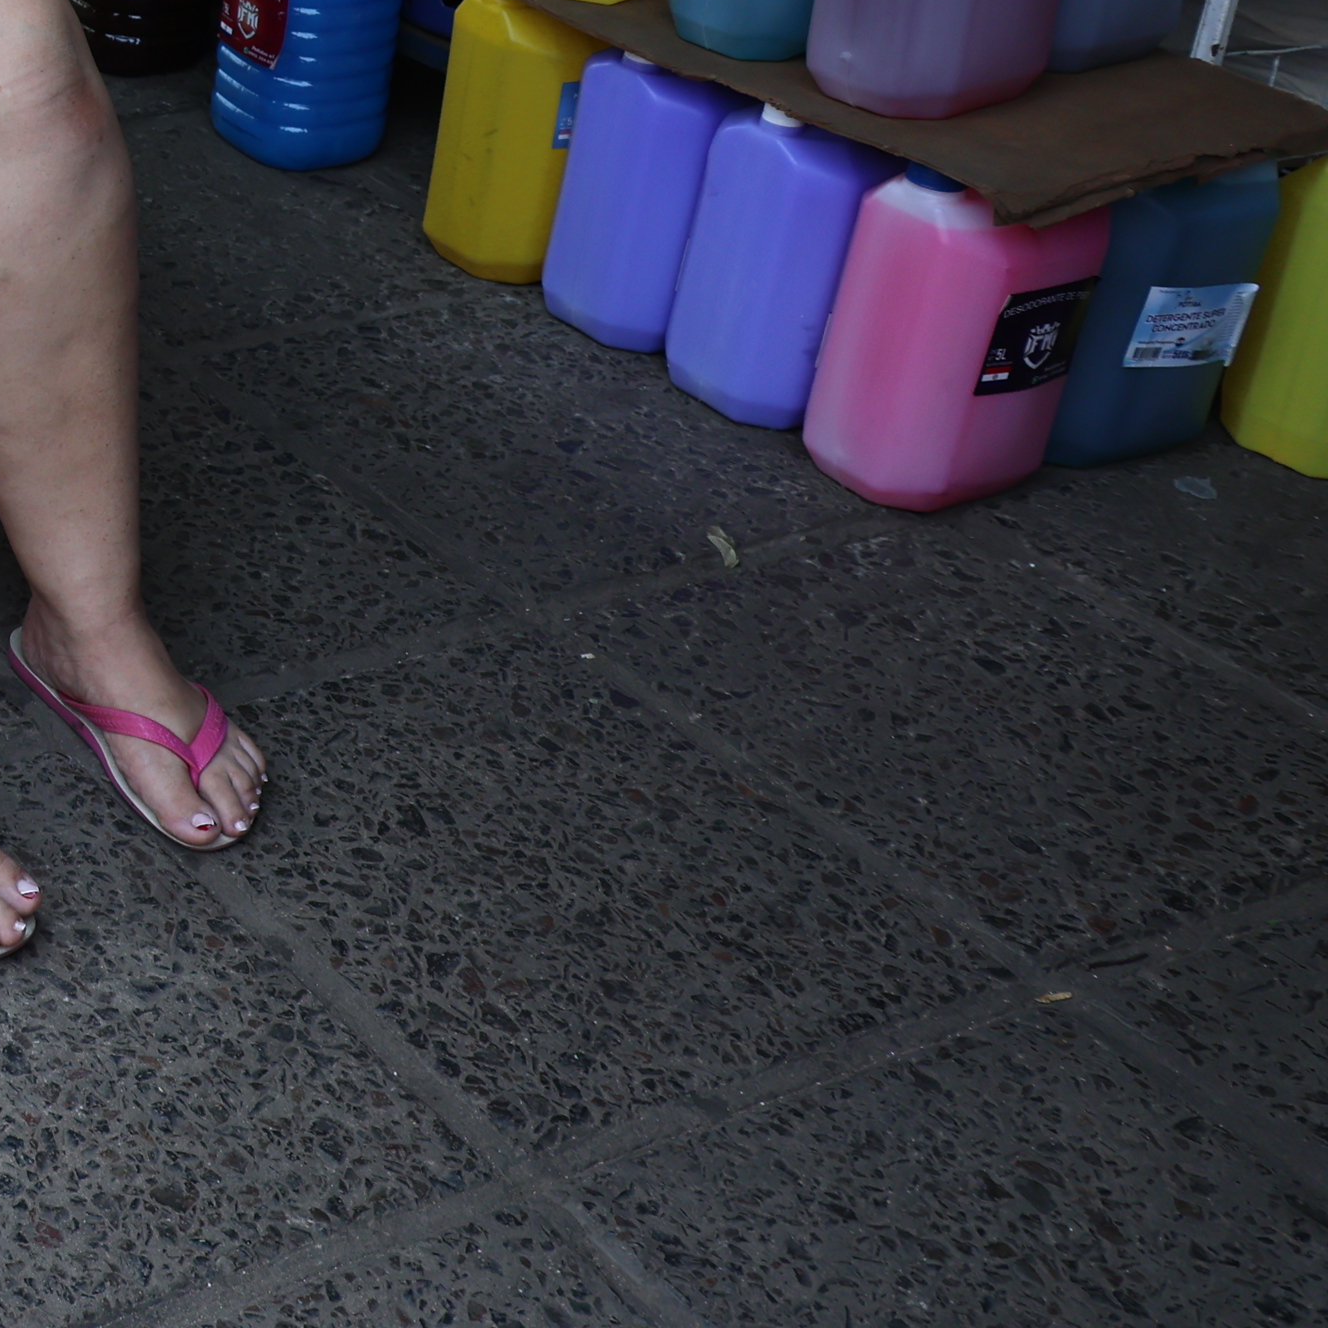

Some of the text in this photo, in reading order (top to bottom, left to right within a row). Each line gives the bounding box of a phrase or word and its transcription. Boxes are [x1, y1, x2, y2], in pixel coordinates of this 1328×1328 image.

[1004, 293, 1066, 318] DESODORANTE
[1146, 308, 1226, 323] DETERGENTE SUPER
[1152, 320, 1216, 332] CONCENTRADO
[995, 348, 1006, 360] 5L
